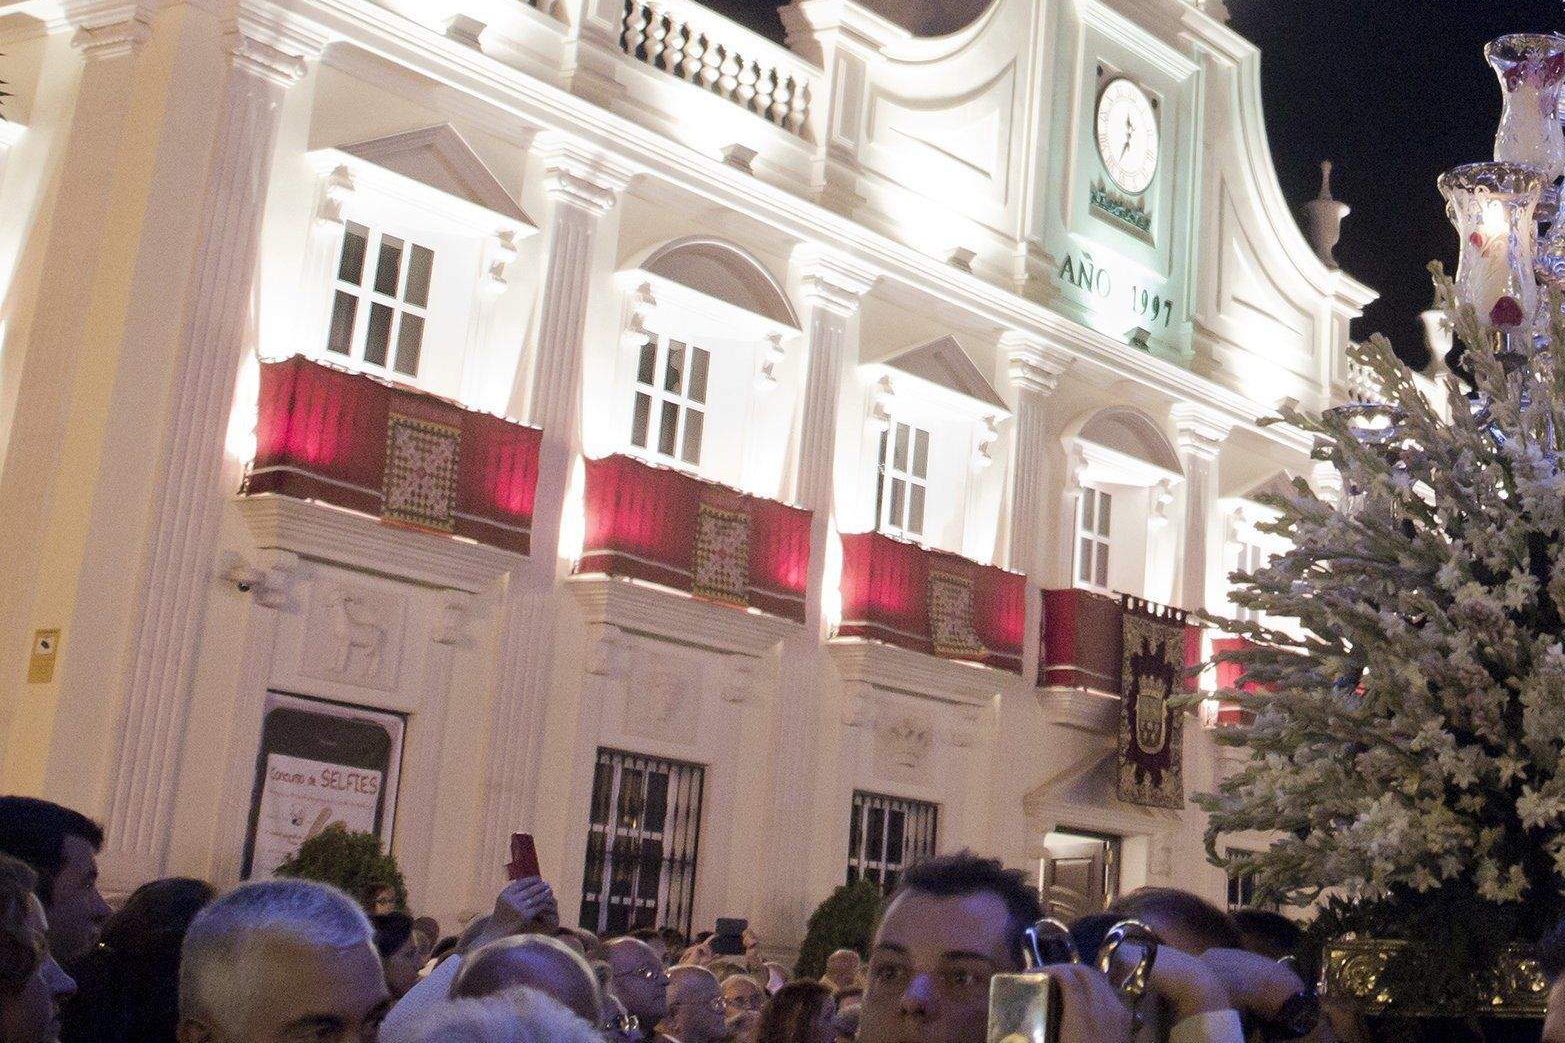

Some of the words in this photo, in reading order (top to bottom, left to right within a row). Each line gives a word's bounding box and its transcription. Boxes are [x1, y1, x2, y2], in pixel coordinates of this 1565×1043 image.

[1060, 250, 1111, 298] AÑO
[1132, 285, 1173, 328] 1997
[320, 769, 378, 795] SELFIES
